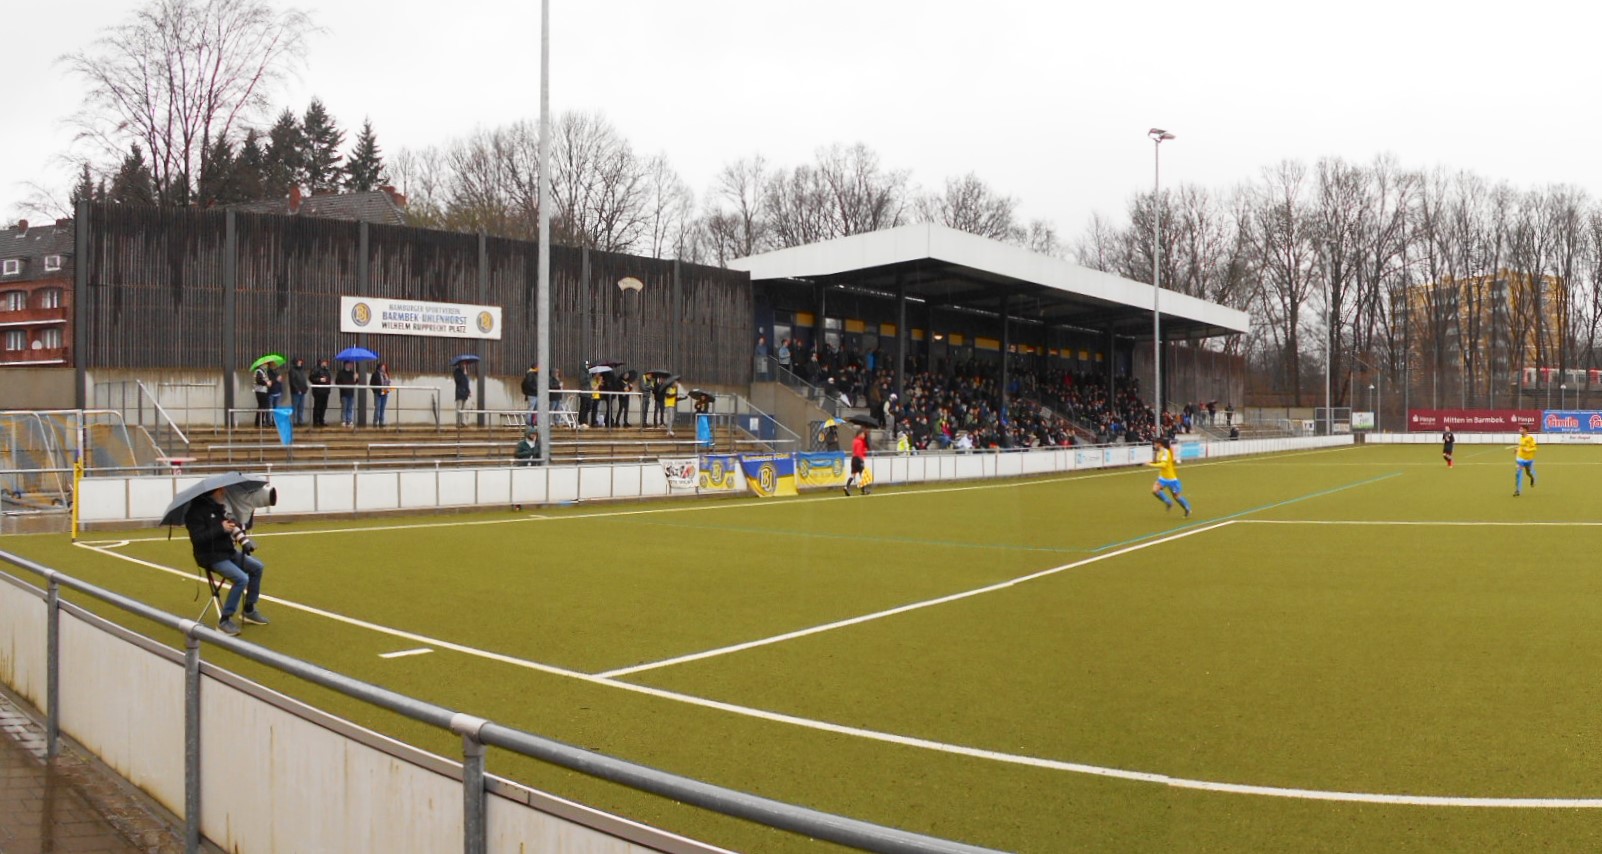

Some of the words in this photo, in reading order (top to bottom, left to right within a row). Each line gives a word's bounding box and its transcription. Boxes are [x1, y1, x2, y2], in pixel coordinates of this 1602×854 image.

[381, 321, 411, 330] WILHELM
[449, 325, 467, 333] PLATZ
[1443, 416, 1465, 424] Mitten
[1474, 416, 1505, 424] Barmbek.
